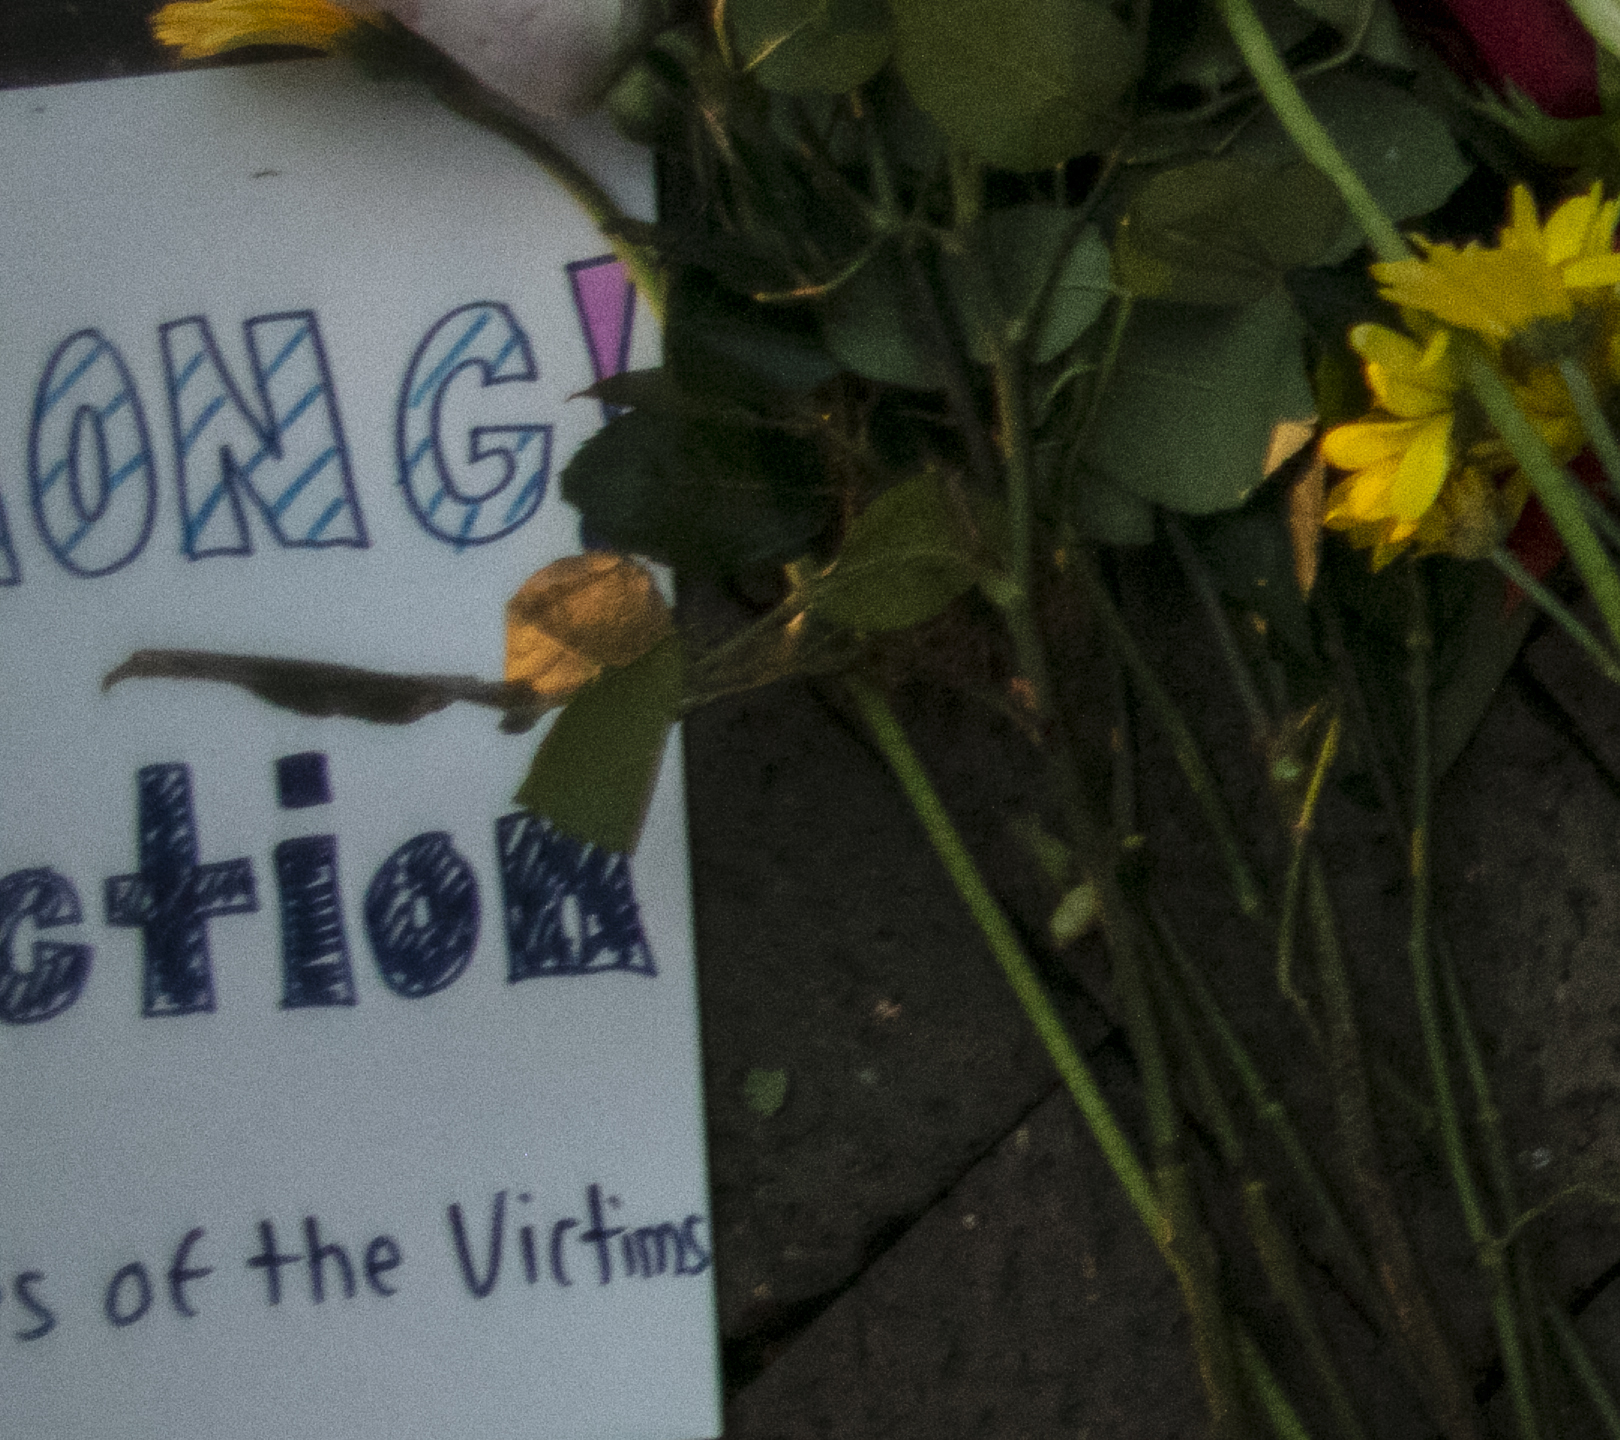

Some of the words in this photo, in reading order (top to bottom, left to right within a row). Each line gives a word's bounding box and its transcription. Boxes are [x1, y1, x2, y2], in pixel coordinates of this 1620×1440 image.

[0, 252, 638, 586] ONG!
[103, 1224, 214, 1329] of
[246, 1214, 402, 1307] the
[447, 1181, 712, 1300] Victims
